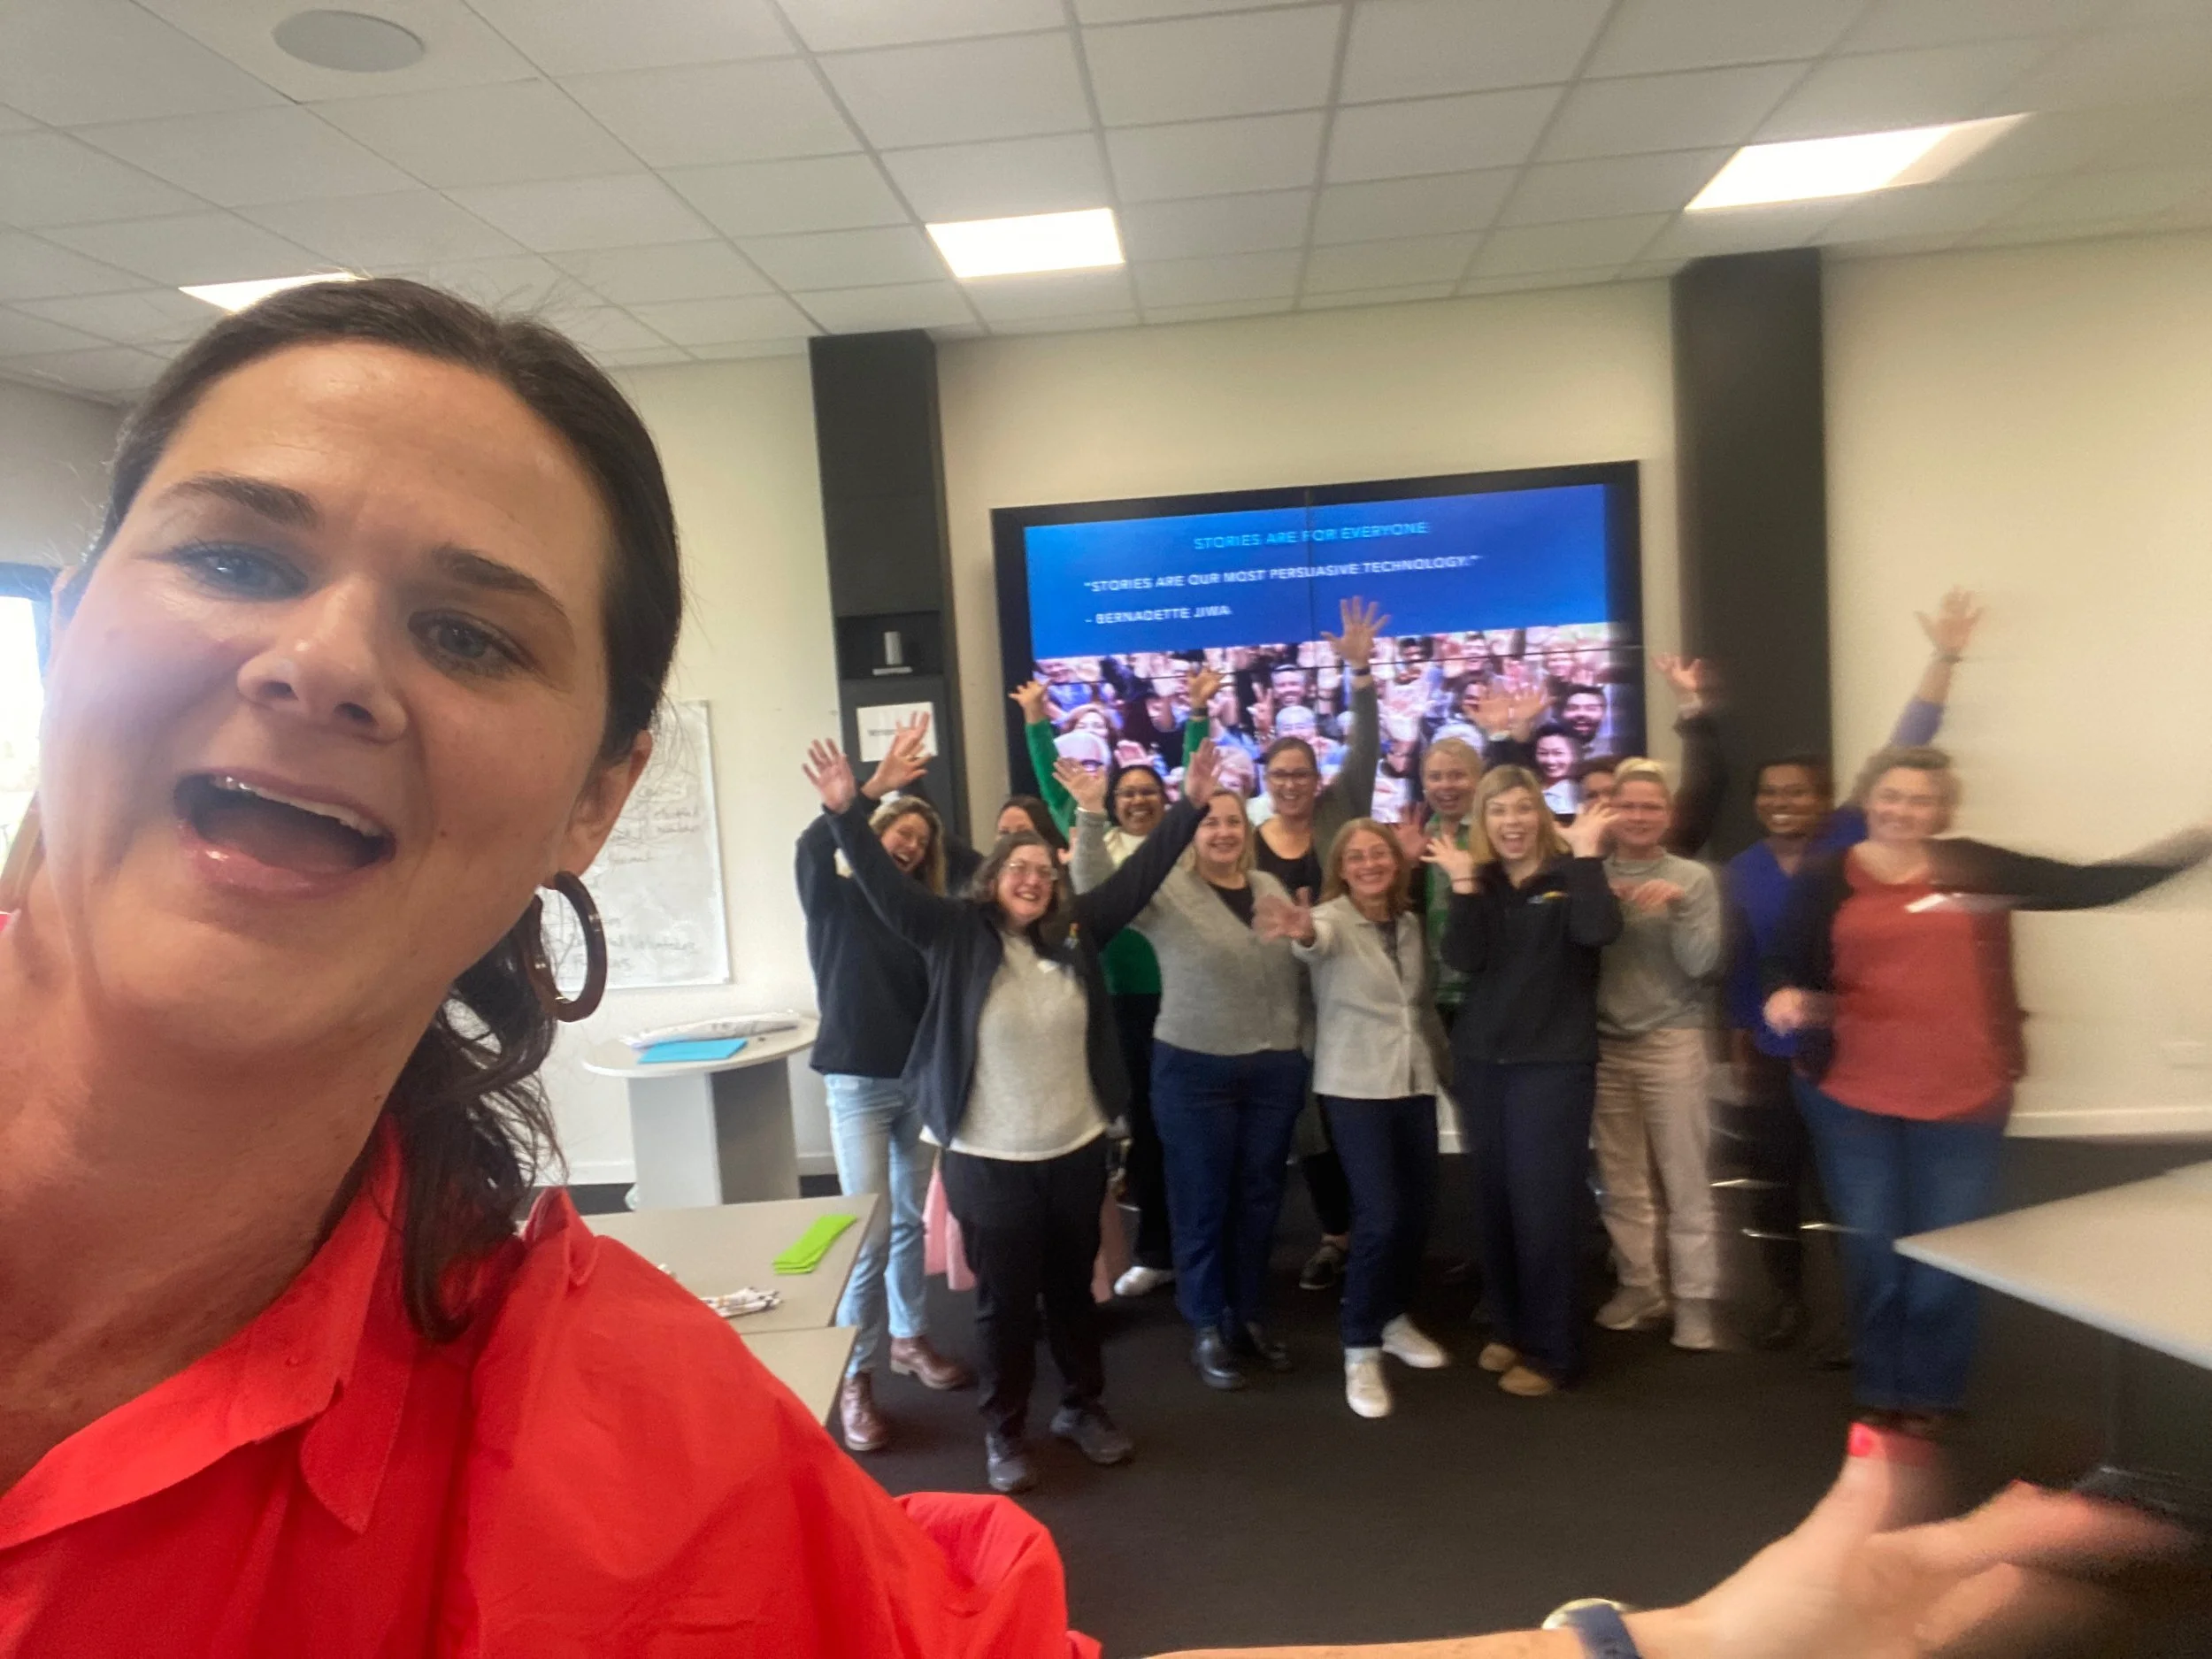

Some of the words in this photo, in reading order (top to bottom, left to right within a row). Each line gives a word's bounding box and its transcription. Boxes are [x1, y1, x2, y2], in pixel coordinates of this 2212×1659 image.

[1194, 534, 1261, 549] STORIES
[1266, 531, 1298, 544] ARE
[1302, 528, 1335, 541] FOR
[1340, 522, 1428, 540] EVERYONE
[1156, 575, 1185, 588] ARE
[1187, 573, 1221, 586] OUR
[1223, 570, 1266, 582] MOST
[1270, 564, 1359, 579] PERSUASIVE
[1095, 608, 1191, 624] BERNADETTE
[1194, 605, 1233, 618] JIWA
